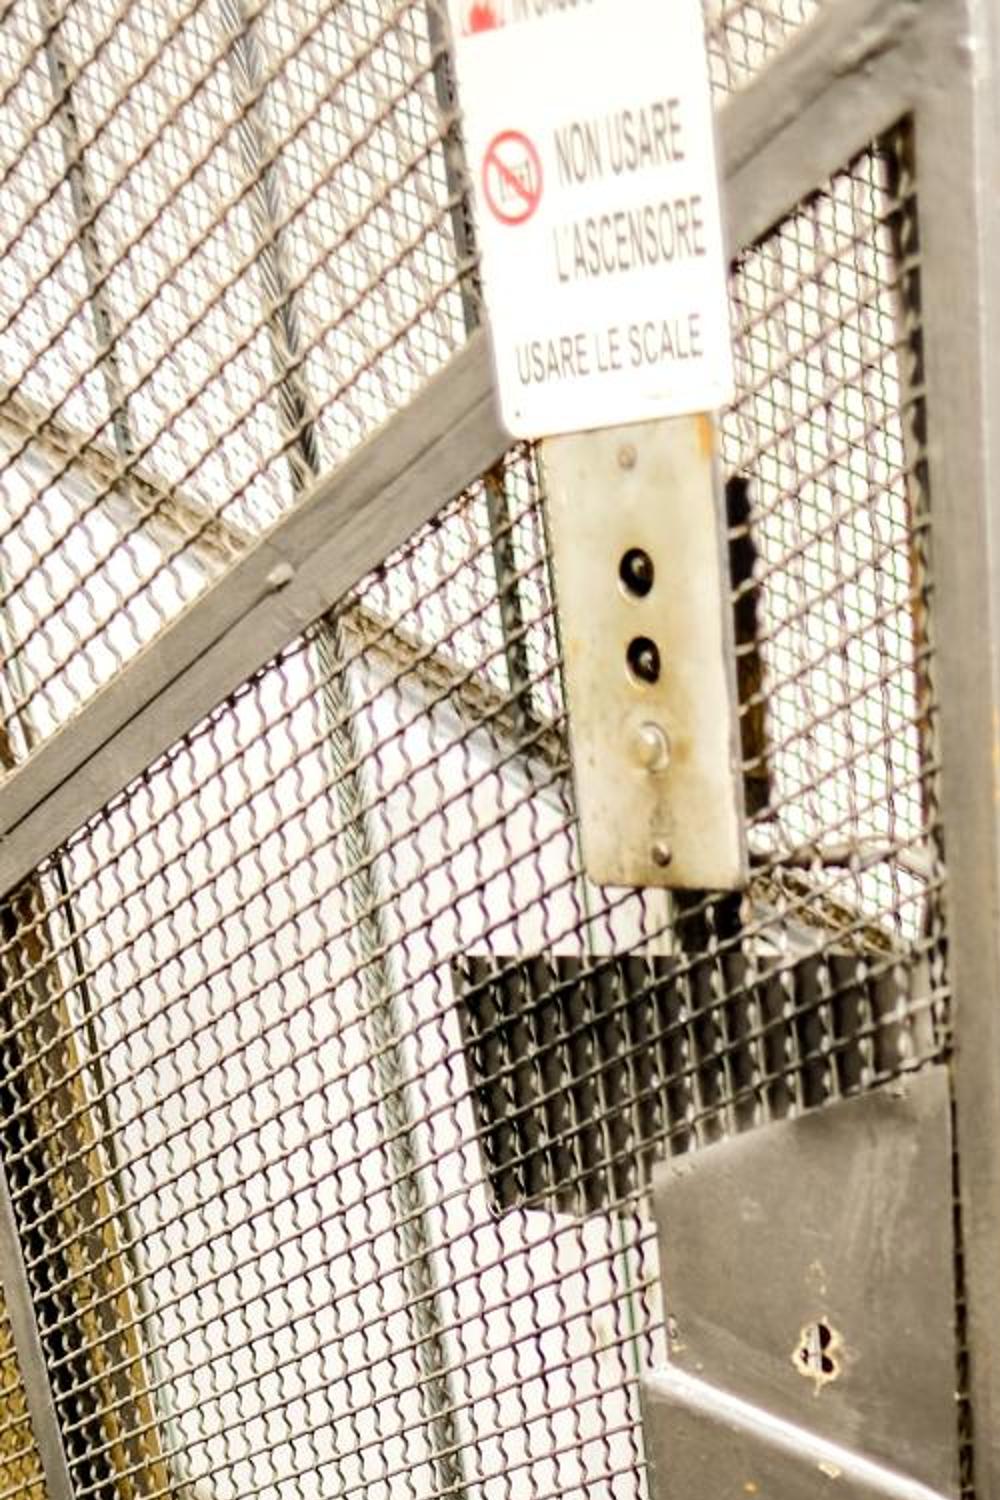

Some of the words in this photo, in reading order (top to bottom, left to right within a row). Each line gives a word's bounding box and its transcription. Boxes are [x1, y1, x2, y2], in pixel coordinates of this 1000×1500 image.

[554, 121, 602, 187] NON
[606, 97, 685, 177] USARE
[553, 194, 707, 284] L'ASCENSORE
[515, 332, 591, 385] USARE
[596, 327, 623, 373] LE
[628, 313, 704, 369] SCALE
